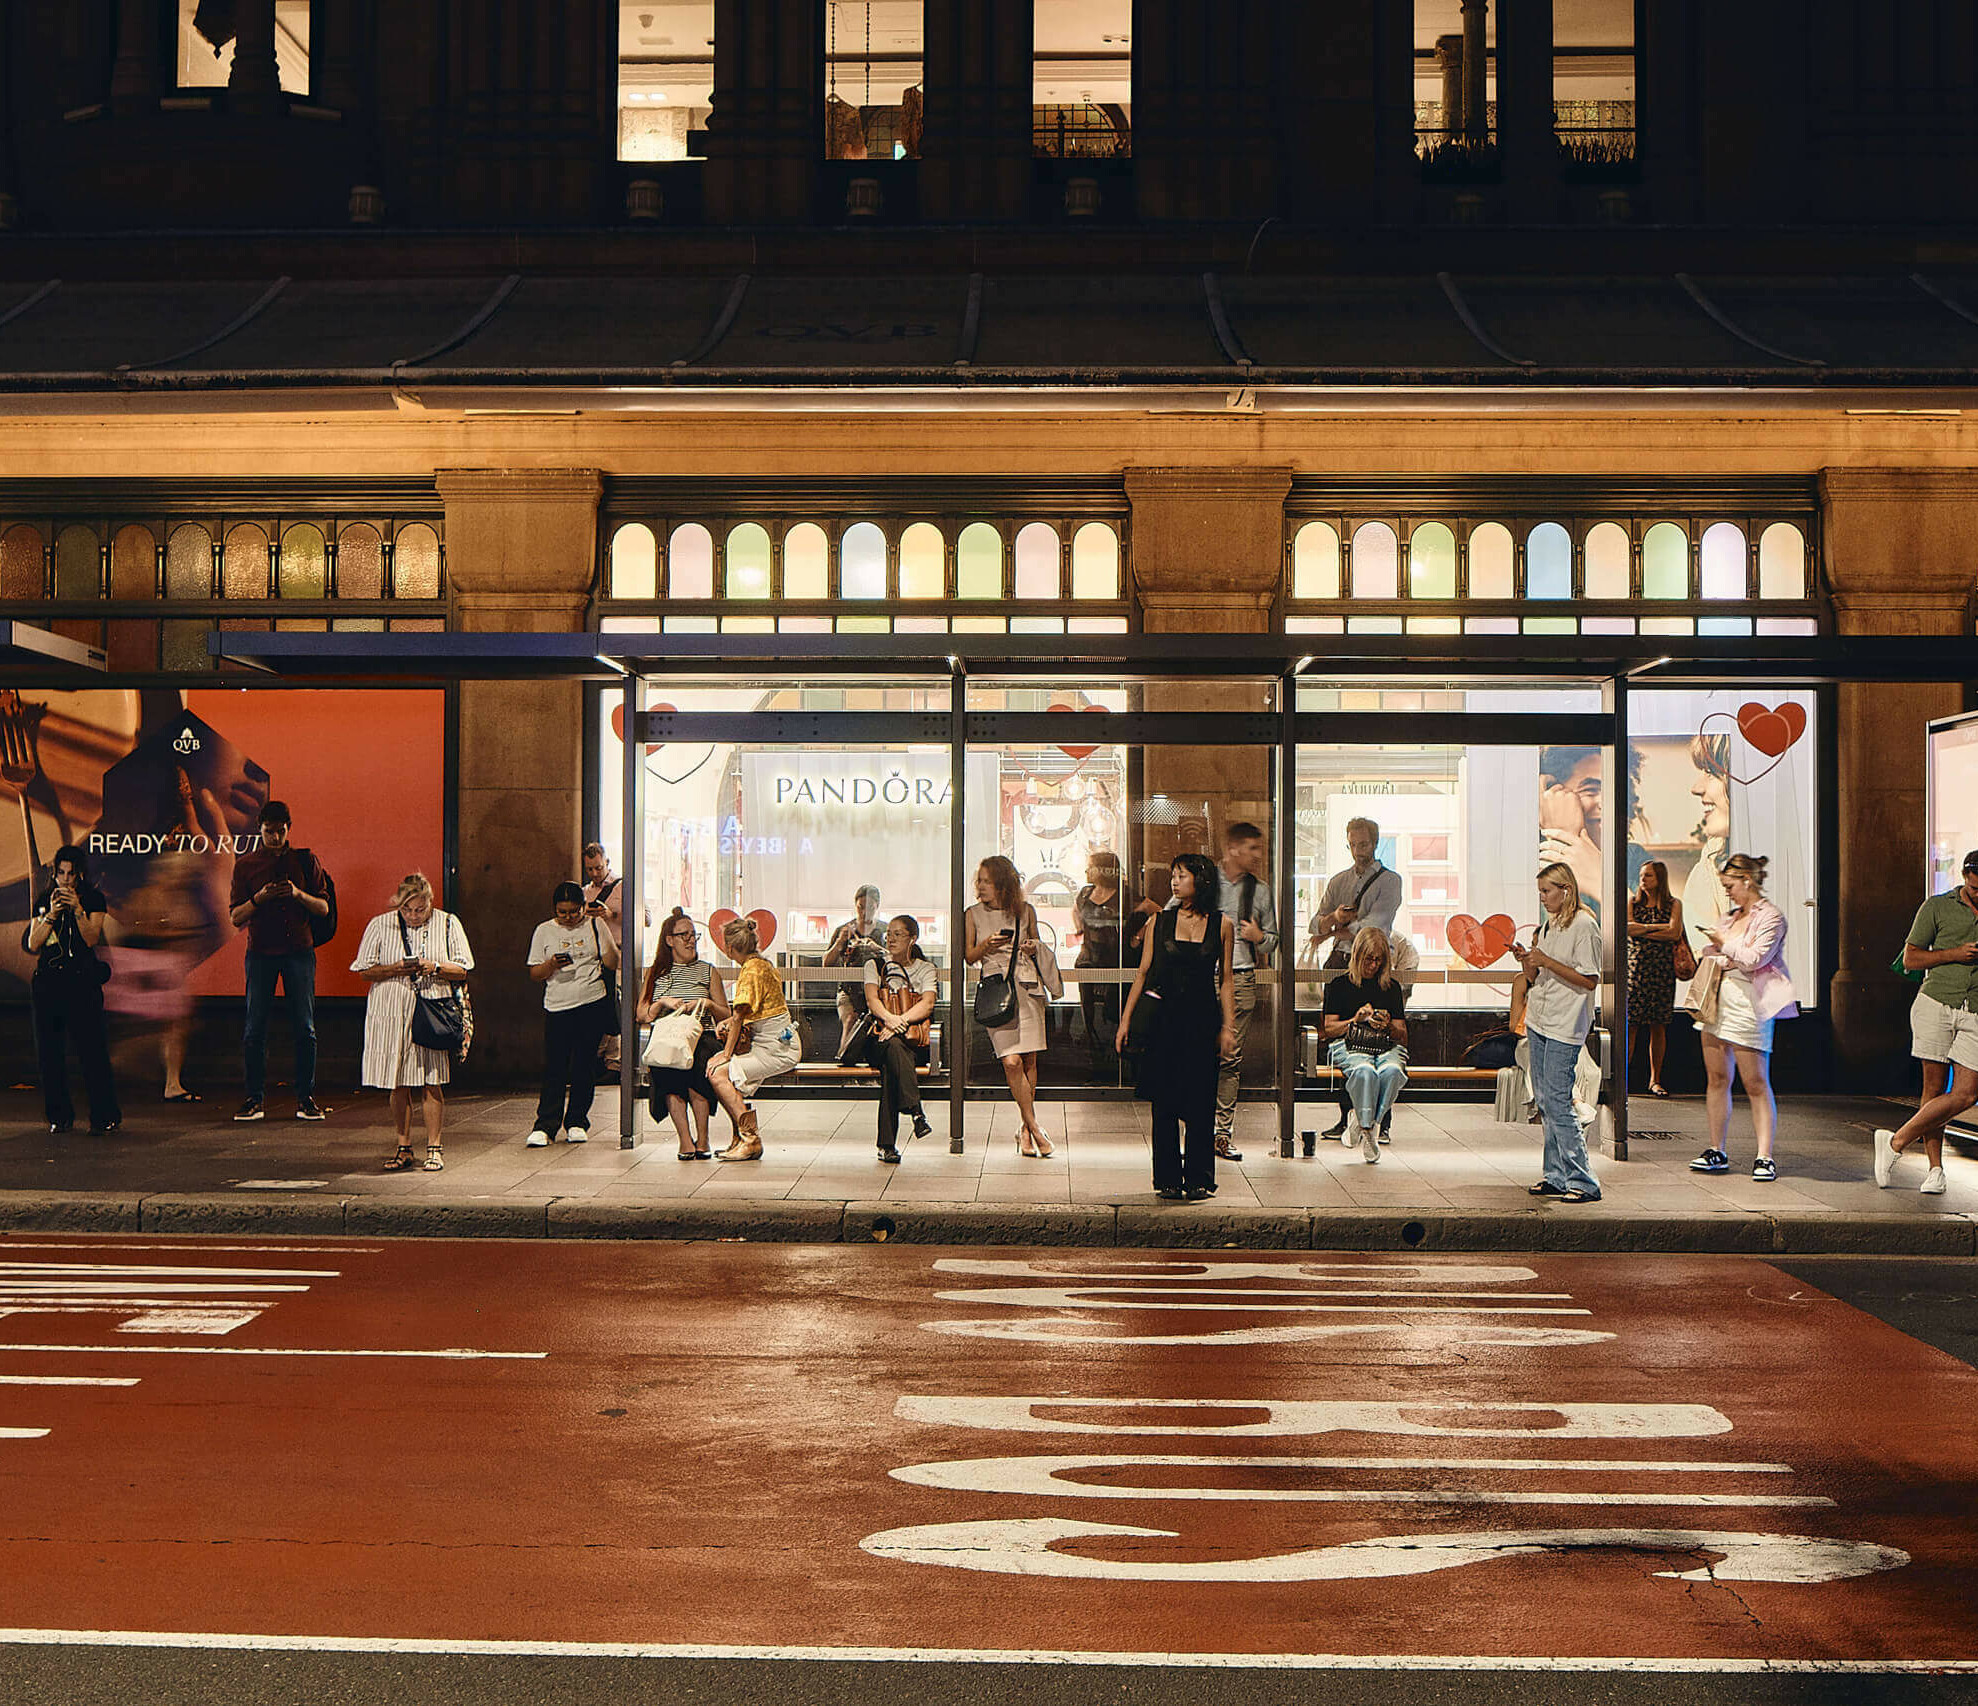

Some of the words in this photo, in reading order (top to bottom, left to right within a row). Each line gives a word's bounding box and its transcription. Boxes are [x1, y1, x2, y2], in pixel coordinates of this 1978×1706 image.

[172, 738, 201, 754] QVB
[89, 834, 167, 854] READY
[174, 834, 209, 854] TO
[920, 1258, 1618, 1346] BUS
[859, 1395, 1911, 1583] BUS
